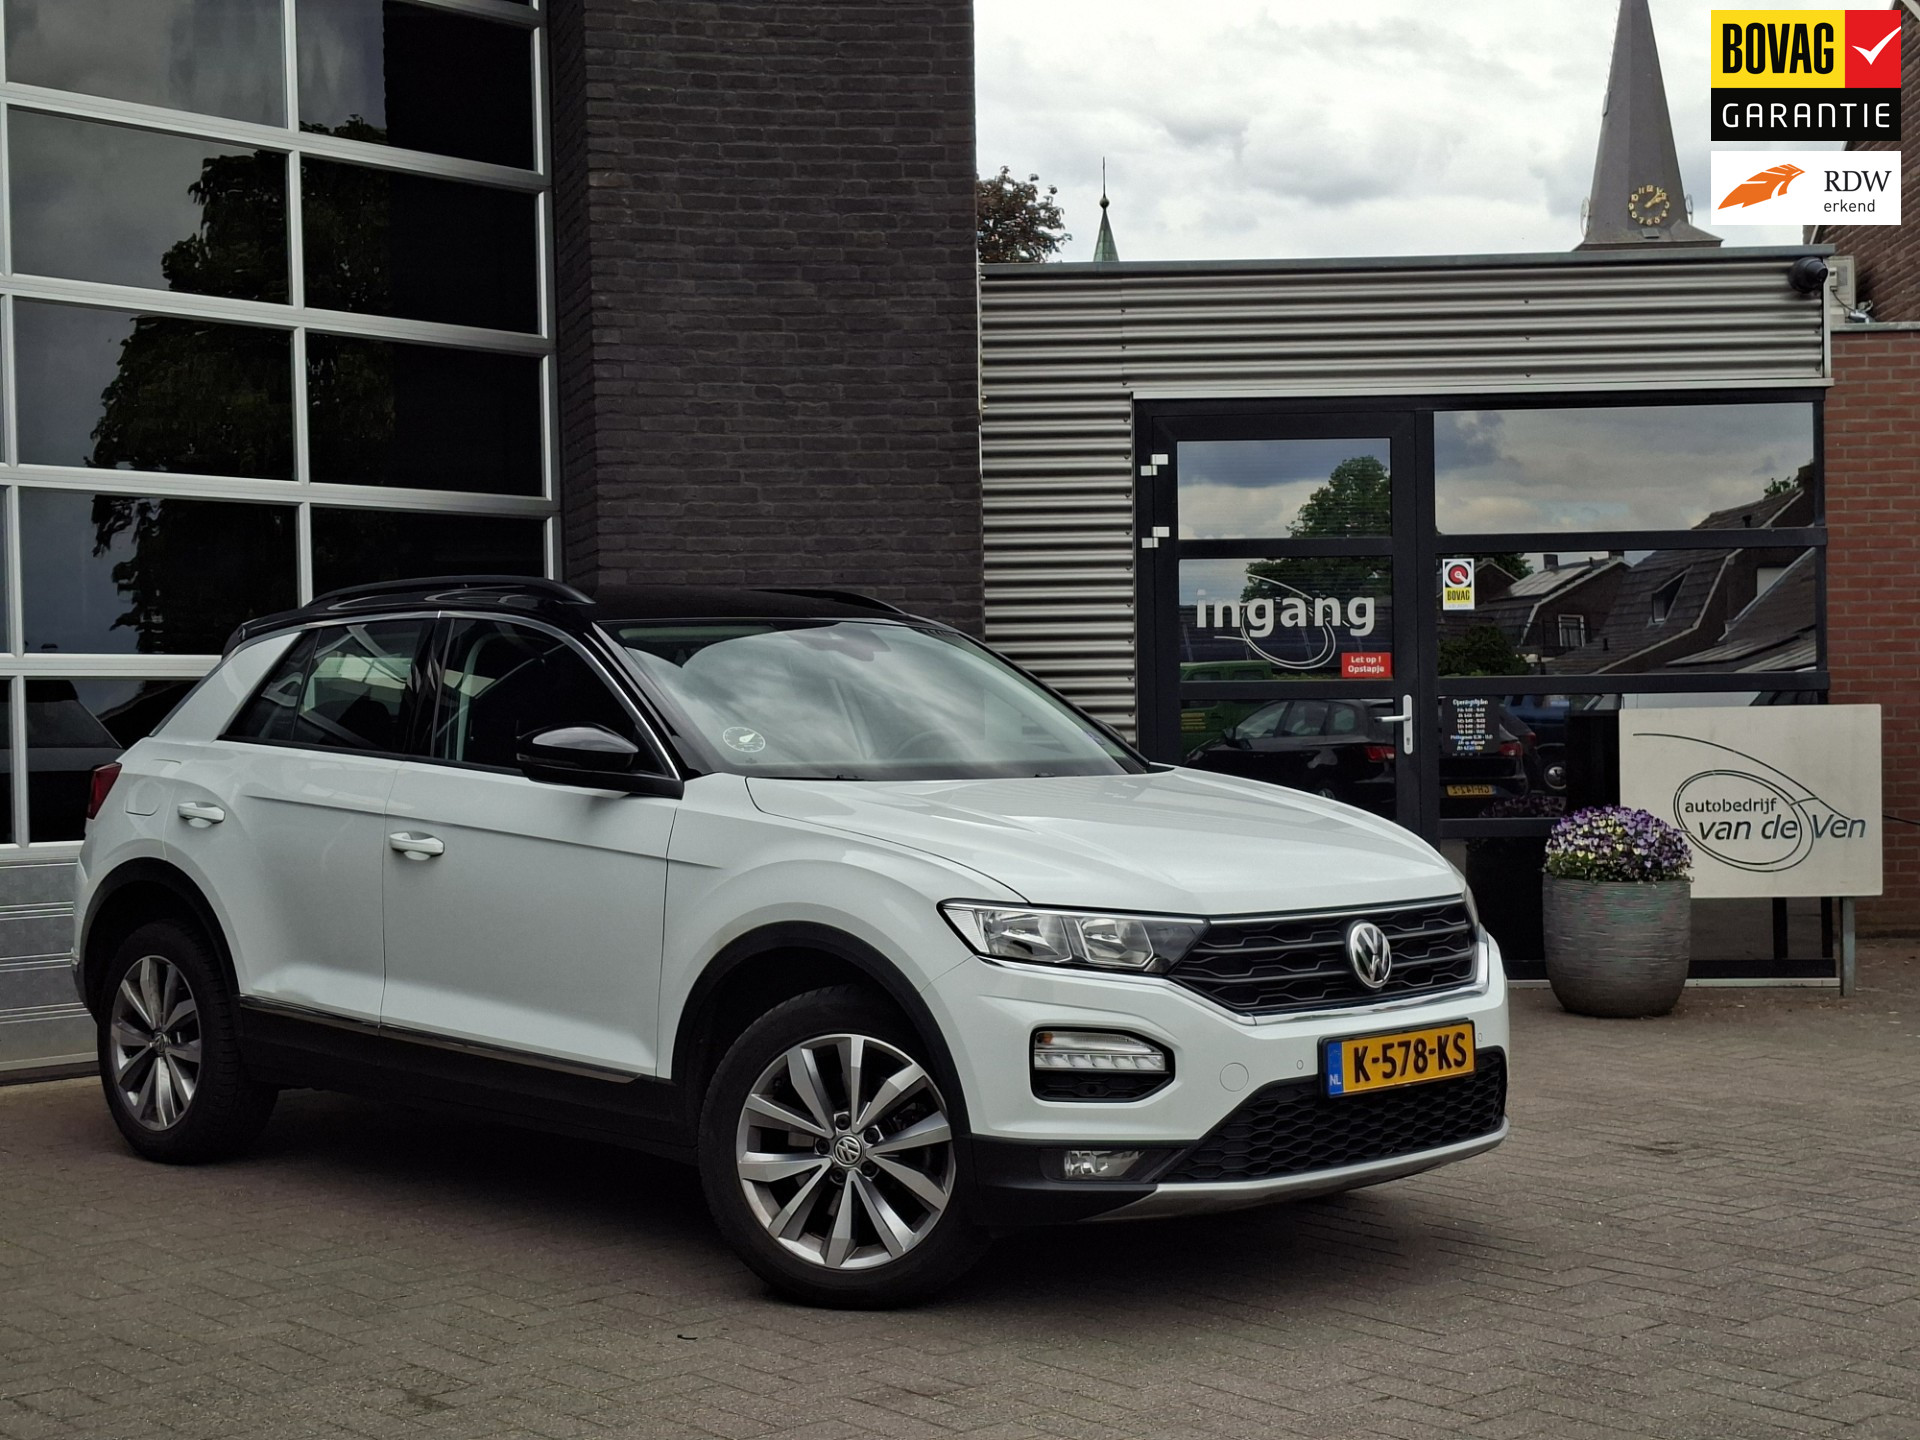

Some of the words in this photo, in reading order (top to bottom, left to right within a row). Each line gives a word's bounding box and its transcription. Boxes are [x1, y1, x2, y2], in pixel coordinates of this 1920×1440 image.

[1447, 590, 1470, 601] BOVAG
[1196, 588, 1375, 638] ingang
[1350, 655, 1364, 664] Let
[1365, 656, 1377, 665] op
[1347, 665, 1385, 674] Opstapje
[1684, 798, 1777, 814] autobedrijf
[1699, 820, 1751, 840] van
[1761, 814, 1798, 840] de
[1812, 814, 1866, 839] Ven
[1353, 1032, 1467, 1084] K-578-KS
[1329, 1074, 1342, 1086] NL
